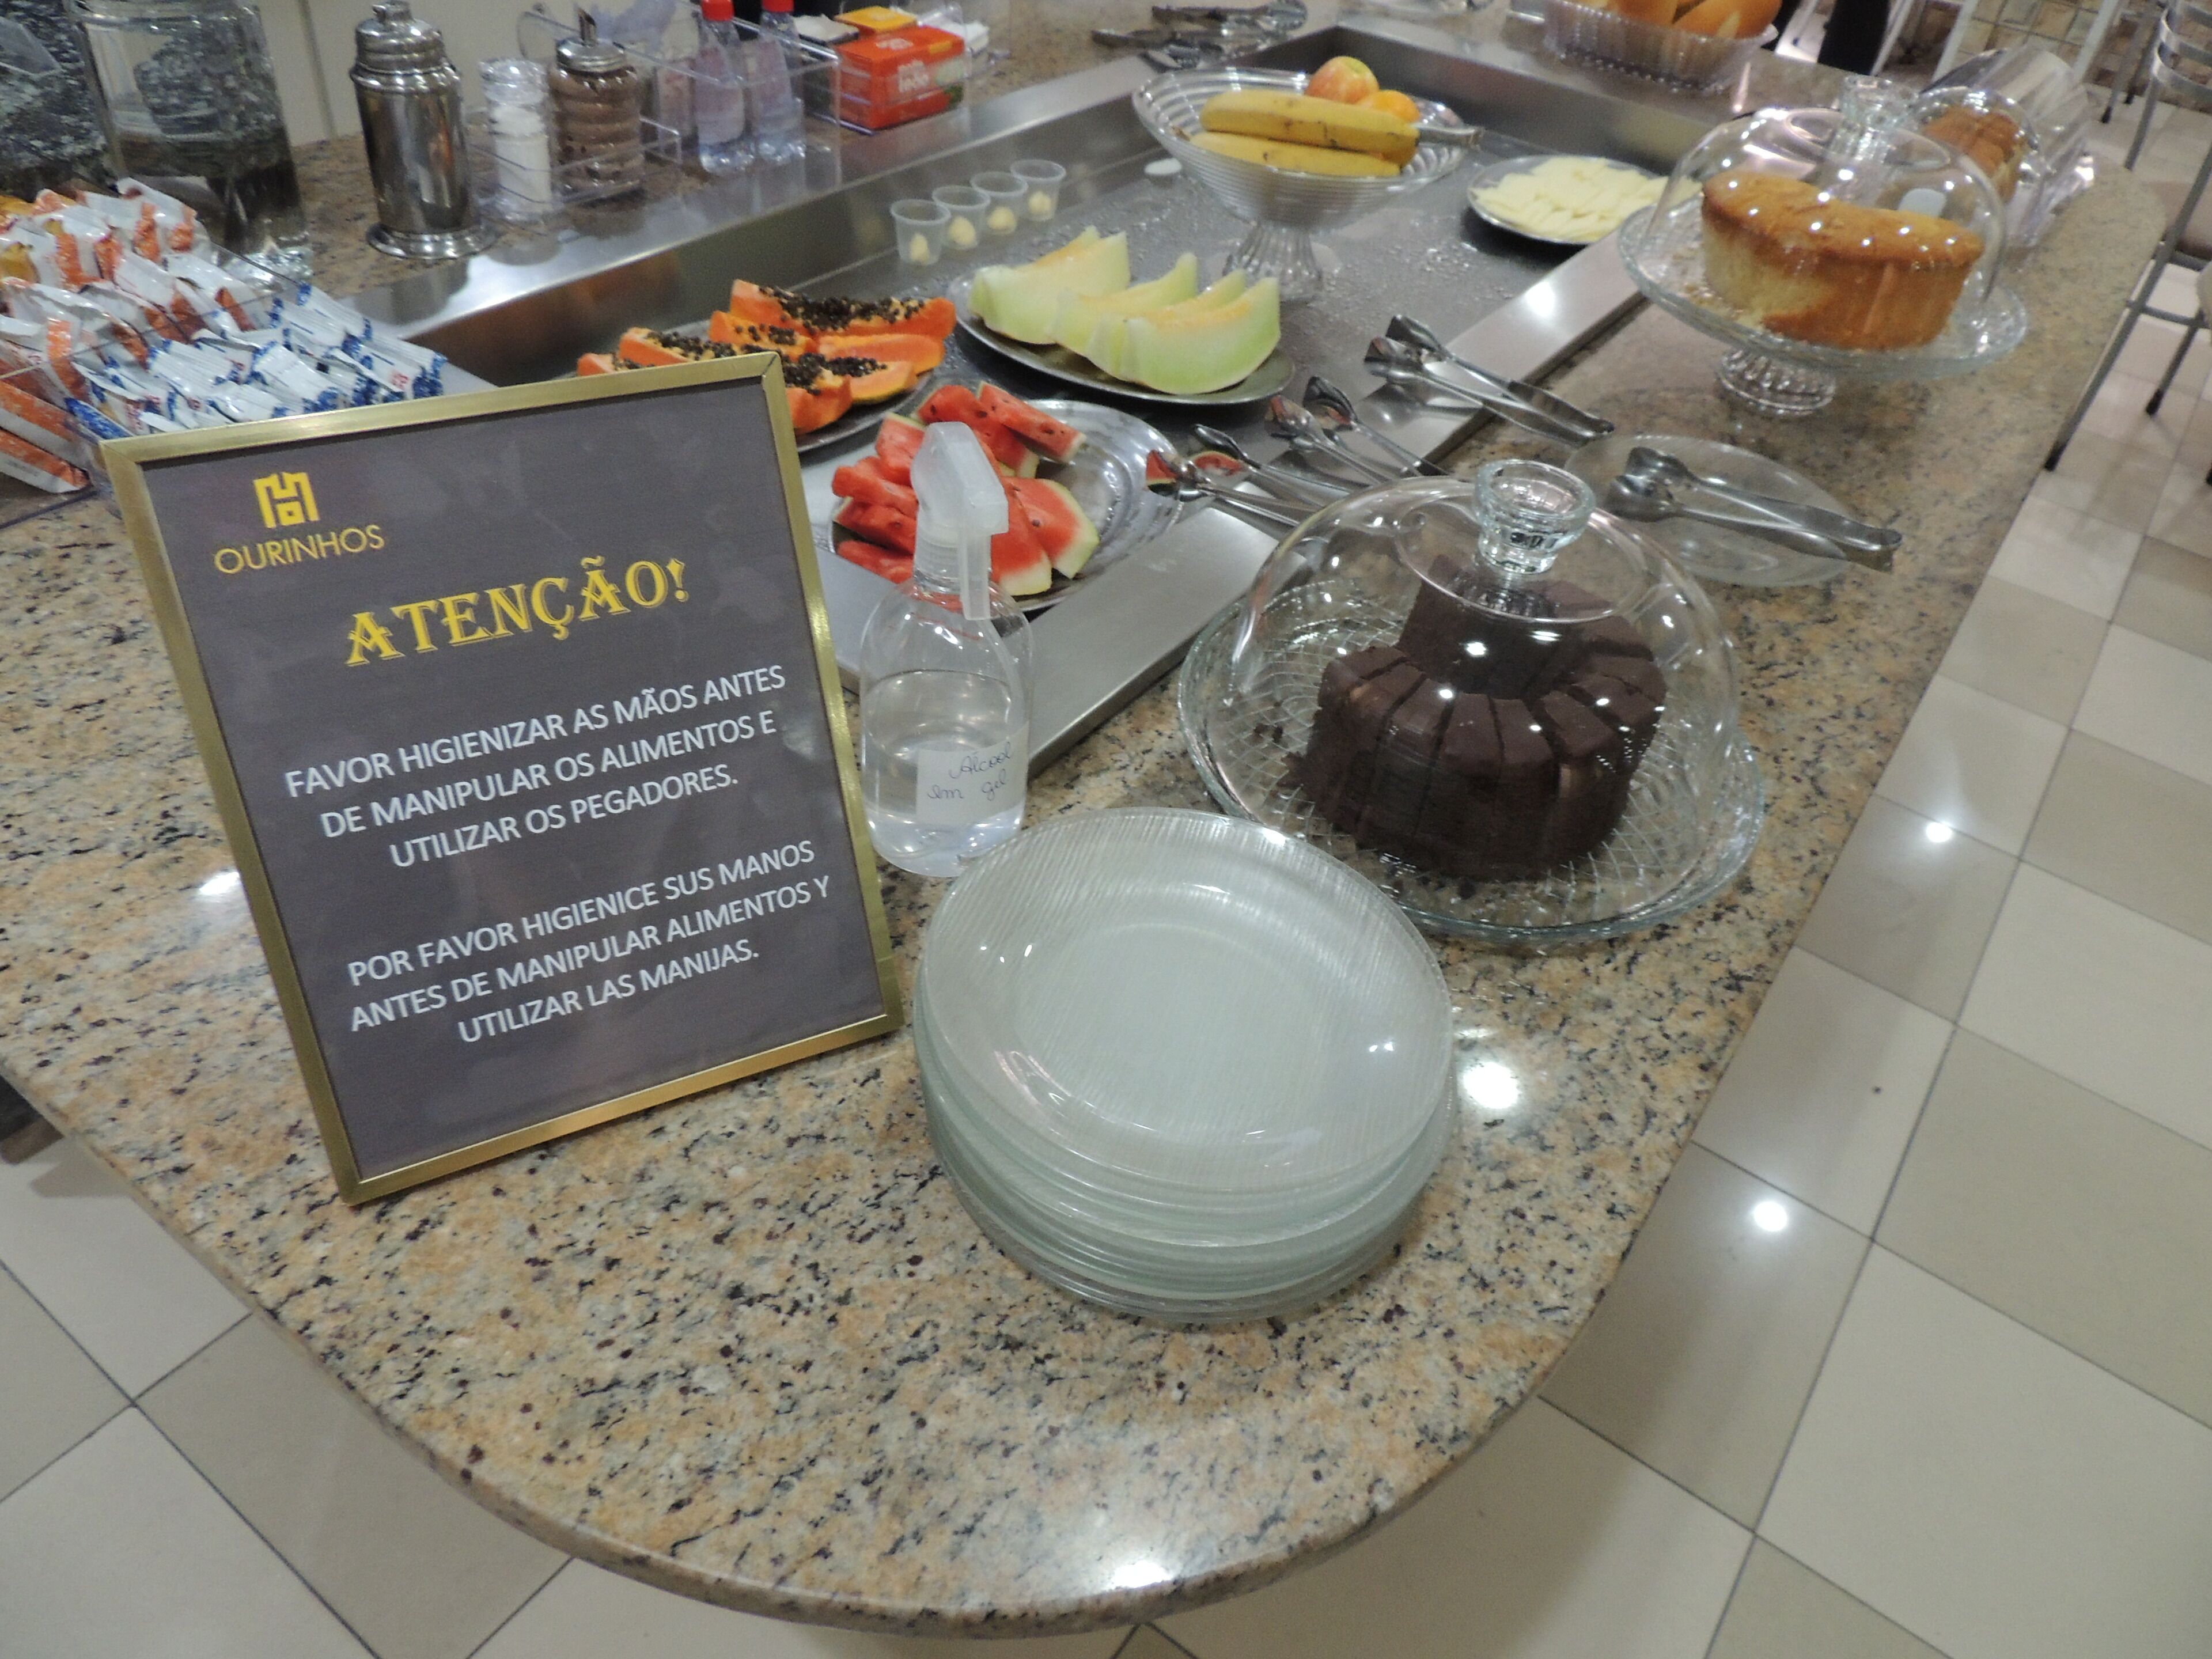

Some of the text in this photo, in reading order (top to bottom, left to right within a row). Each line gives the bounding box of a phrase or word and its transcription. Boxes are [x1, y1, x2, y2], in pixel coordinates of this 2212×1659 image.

[215, 524, 384, 574] OURINHOS
[347, 555, 685, 666] ATENÇÃO!
[285, 665, 786, 797] FAVOR HIGIENIZAR AS MÃOS ANTES
[320, 710, 777, 838] DE MANIPULAR OS ALIMENTOS E
[981, 768, 1006, 801] gel
[389, 764, 738, 867] UTILIZAR OS PEGADORES.
[348, 840, 815, 986] POR FAVOR HIGIENICE SUS MANOS
[352, 875, 829, 1032] ANTES DE MANIPULAR ALIMENTOS Y
[458, 939, 759, 1042] UTILIZAR LAS MANIJAS.
